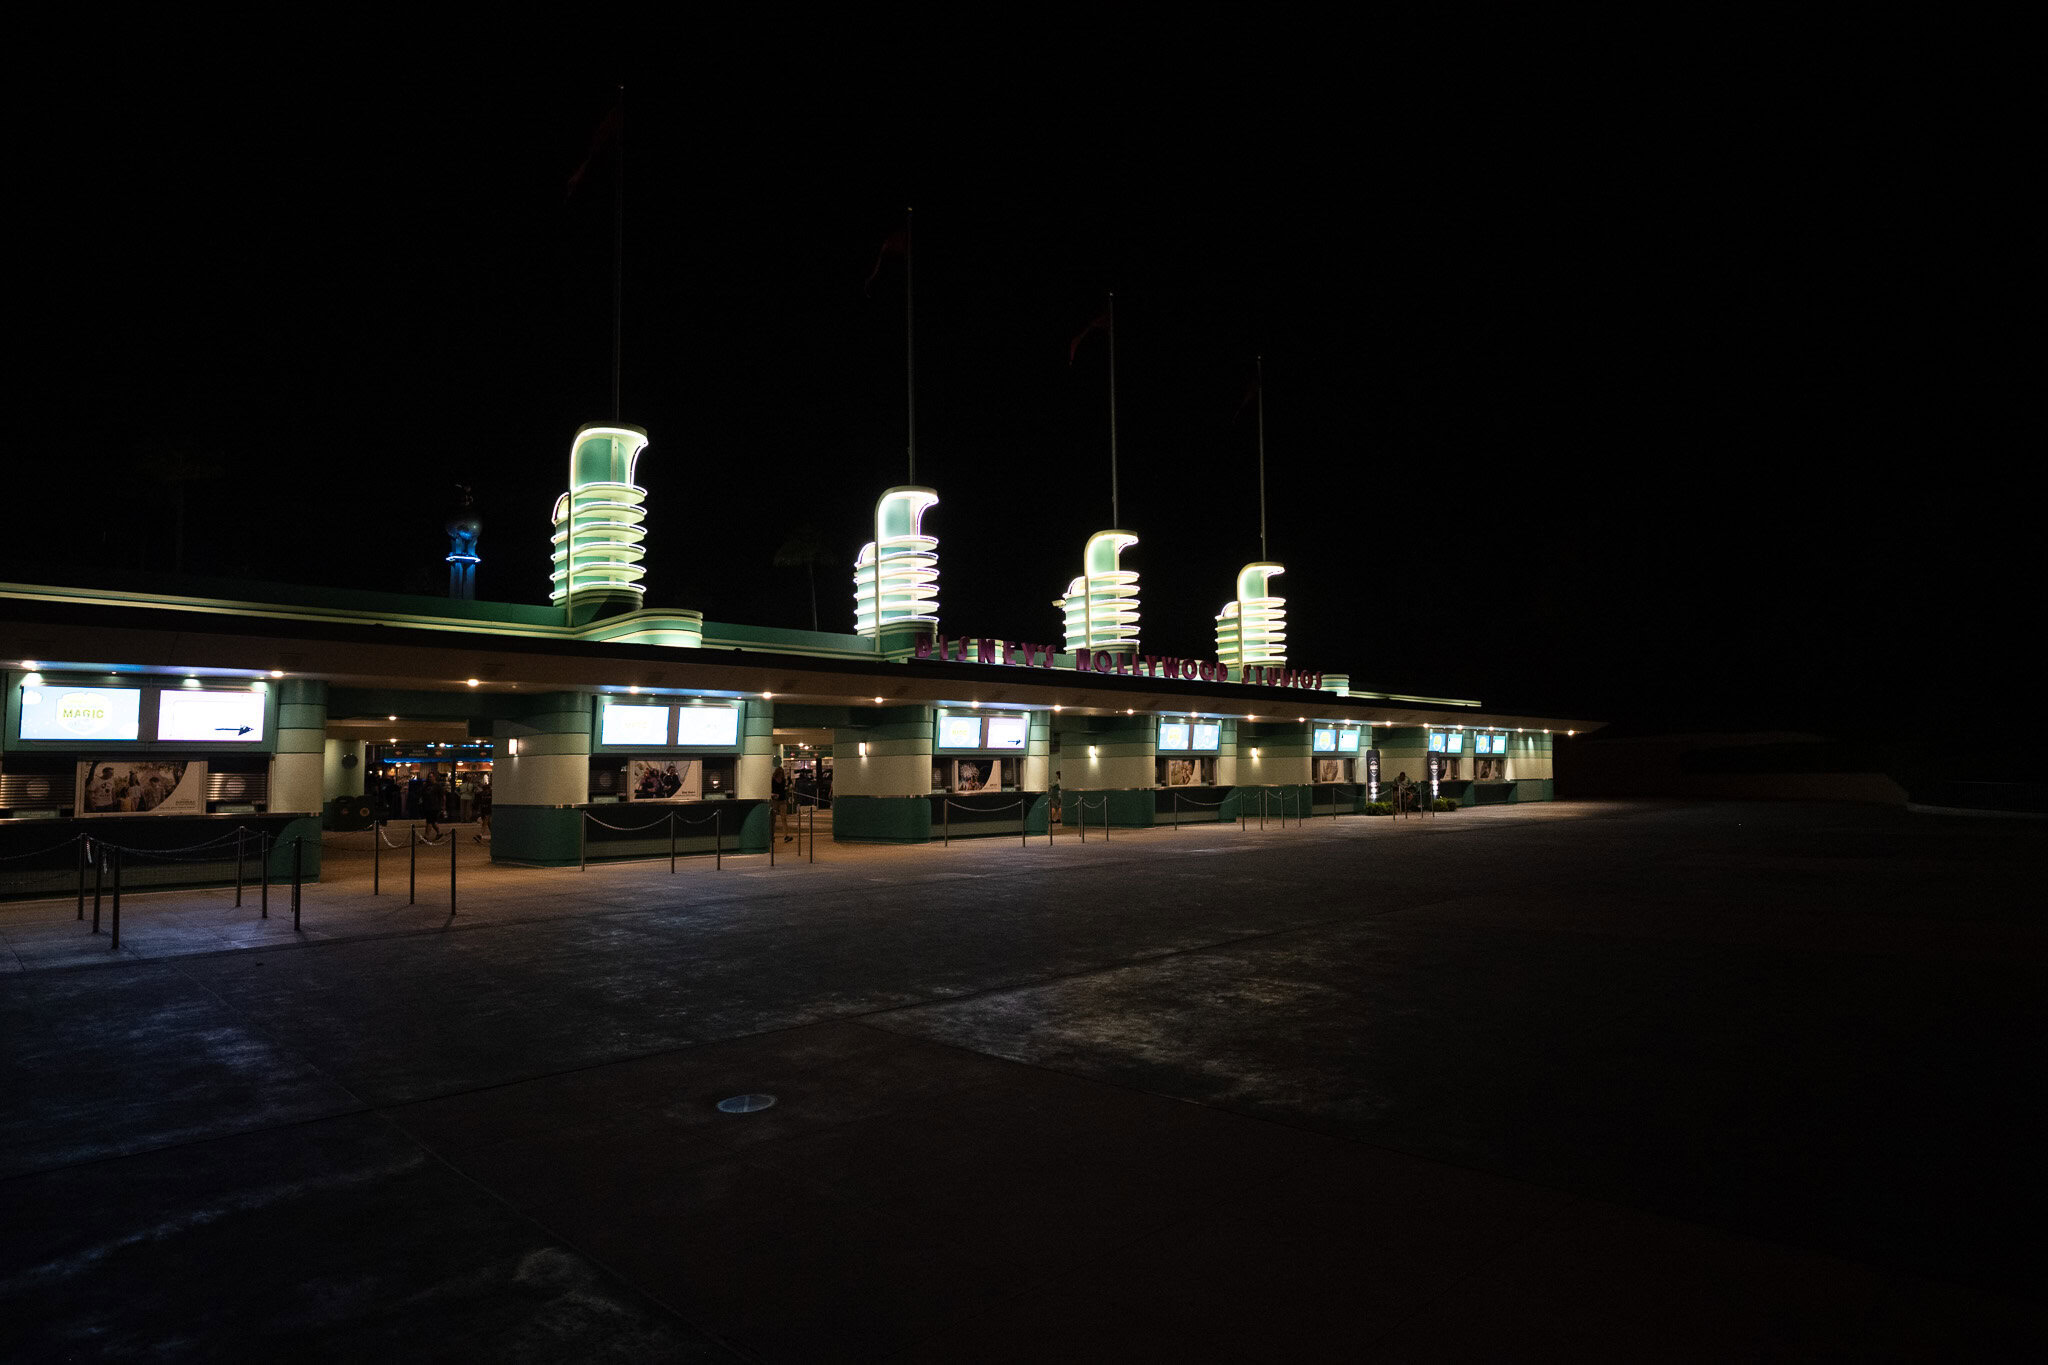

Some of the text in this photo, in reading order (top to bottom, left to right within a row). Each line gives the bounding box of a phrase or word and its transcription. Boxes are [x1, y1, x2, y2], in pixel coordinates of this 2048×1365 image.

[915, 632, 1323, 690] DISNEY'S HOLLYWOOD STUDIOS
[63, 709, 105, 719] MAGIC
